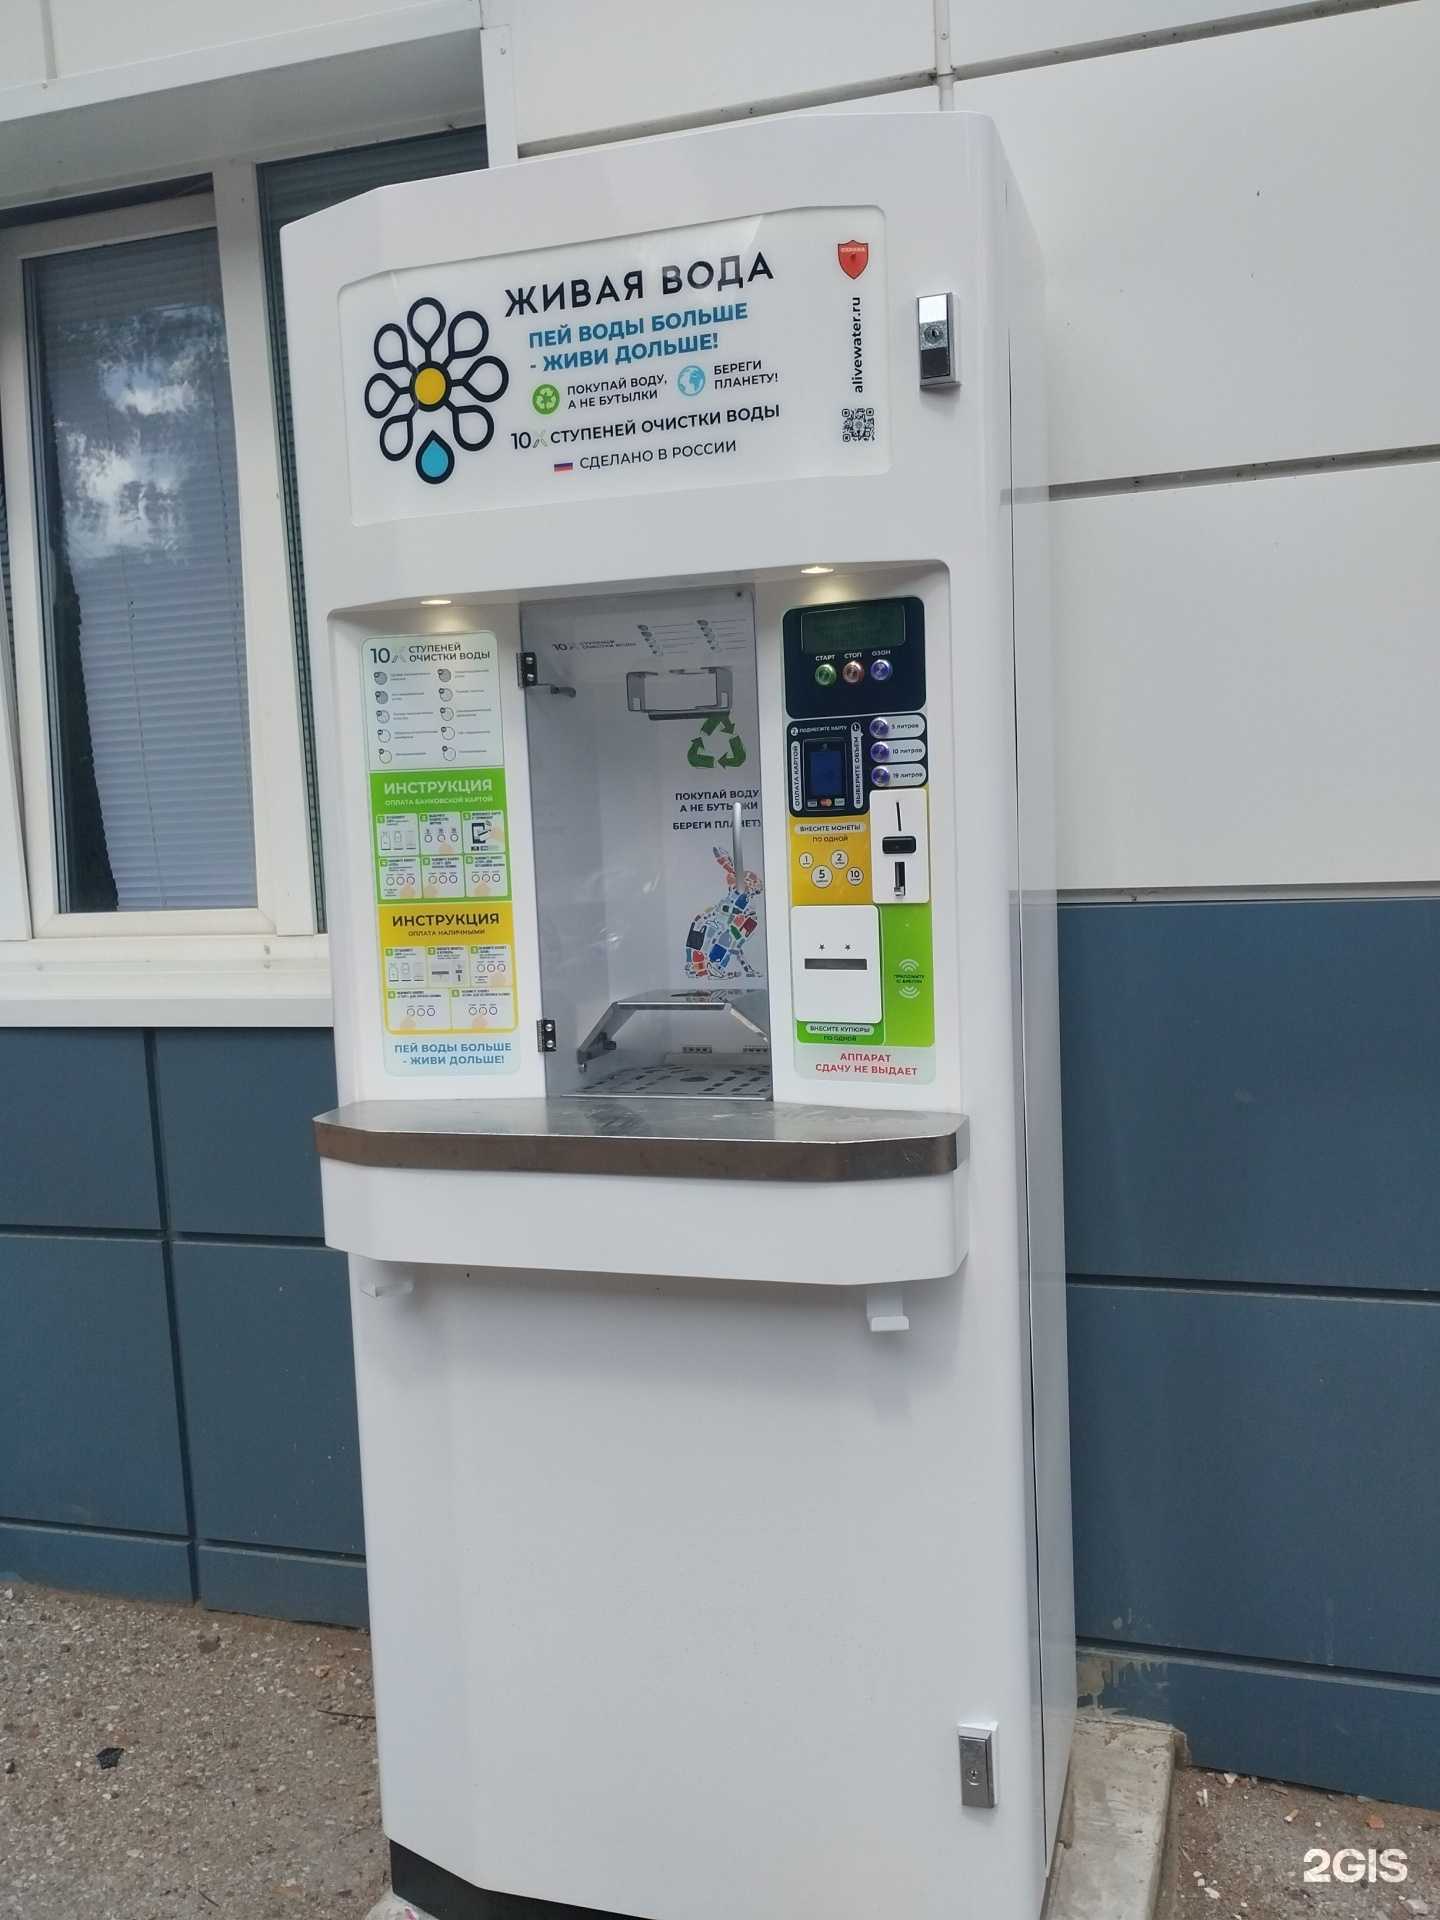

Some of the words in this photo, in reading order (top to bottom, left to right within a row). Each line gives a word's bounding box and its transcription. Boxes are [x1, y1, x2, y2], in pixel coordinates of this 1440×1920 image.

[505, 270, 643, 317] ЖИВАЯ
[662, 252, 774, 294] ВОДА
[529, 324, 572, 348] ПЕЙ
[579, 318, 644, 342] ВОДЫ
[652, 303, 748, 331] БОЛЬШЕ
[543, 349, 608, 371] ЖИВИ
[615, 333, 718, 364] ДОЛЬШЕ!
[851, 297, 863, 393] alivewater.ru
[714, 360, 762, 375] БЕРЕГИ
[567, 377, 627, 396] ПОКУПАЙ
[631, 374, 667, 390] ВОДУ,
[715, 373, 778, 389] ПЛАНЕТУ!
[568, 400, 577, 409] А
[580, 397, 596, 408] НЕ
[600, 390, 658, 406] БУТЫЛКИ
[550, 420, 636, 444] СТУПЕНЕЙ
[641, 412, 721, 433] ОЧИСТКИ
[727, 404, 780, 422] ВОДЫ
[580, 450, 653, 470] СДЕЛАНО
[658, 449, 668, 460] В
[672, 440, 737, 458] РОССИИ
[409, 643, 461, 652] СТУПЕНЕЙ
[409, 652, 456, 663] ОЧИСТКИ
[459, 651, 490, 662] ВОДЫ
[384, 779, 493, 795] ИНСТРУКЦИЯ
[675, 788, 727, 801] ПОКУПАЙ
[730, 788, 760, 800] ВОДУ
[680, 804, 688, 812] А
[690, 803, 704, 812] НЕ
[673, 820, 711, 830] БЕРЕГИ
[819, 870, 825, 879] 5
[850, 870, 860, 878] 10
[392, 913, 499, 927] ИНСТРУКЦИЯ
[394, 1043, 418, 1053] ПЕЙ
[422, 1043, 457, 1054] ВОДЫ
[461, 1042, 511, 1052] БОЛЬШЕ
[410, 1056, 446, 1065] ЖИВИ
[449, 1055, 504, 1066] ДОЛЬШЕ!
[840, 1053, 892, 1062] АППАРАТ
[816, 1064, 851, 1073] СДАЧУ
[854, 1065, 868, 1073] НЕ
[872, 1066, 918, 1076] ВЫДАЕТ
